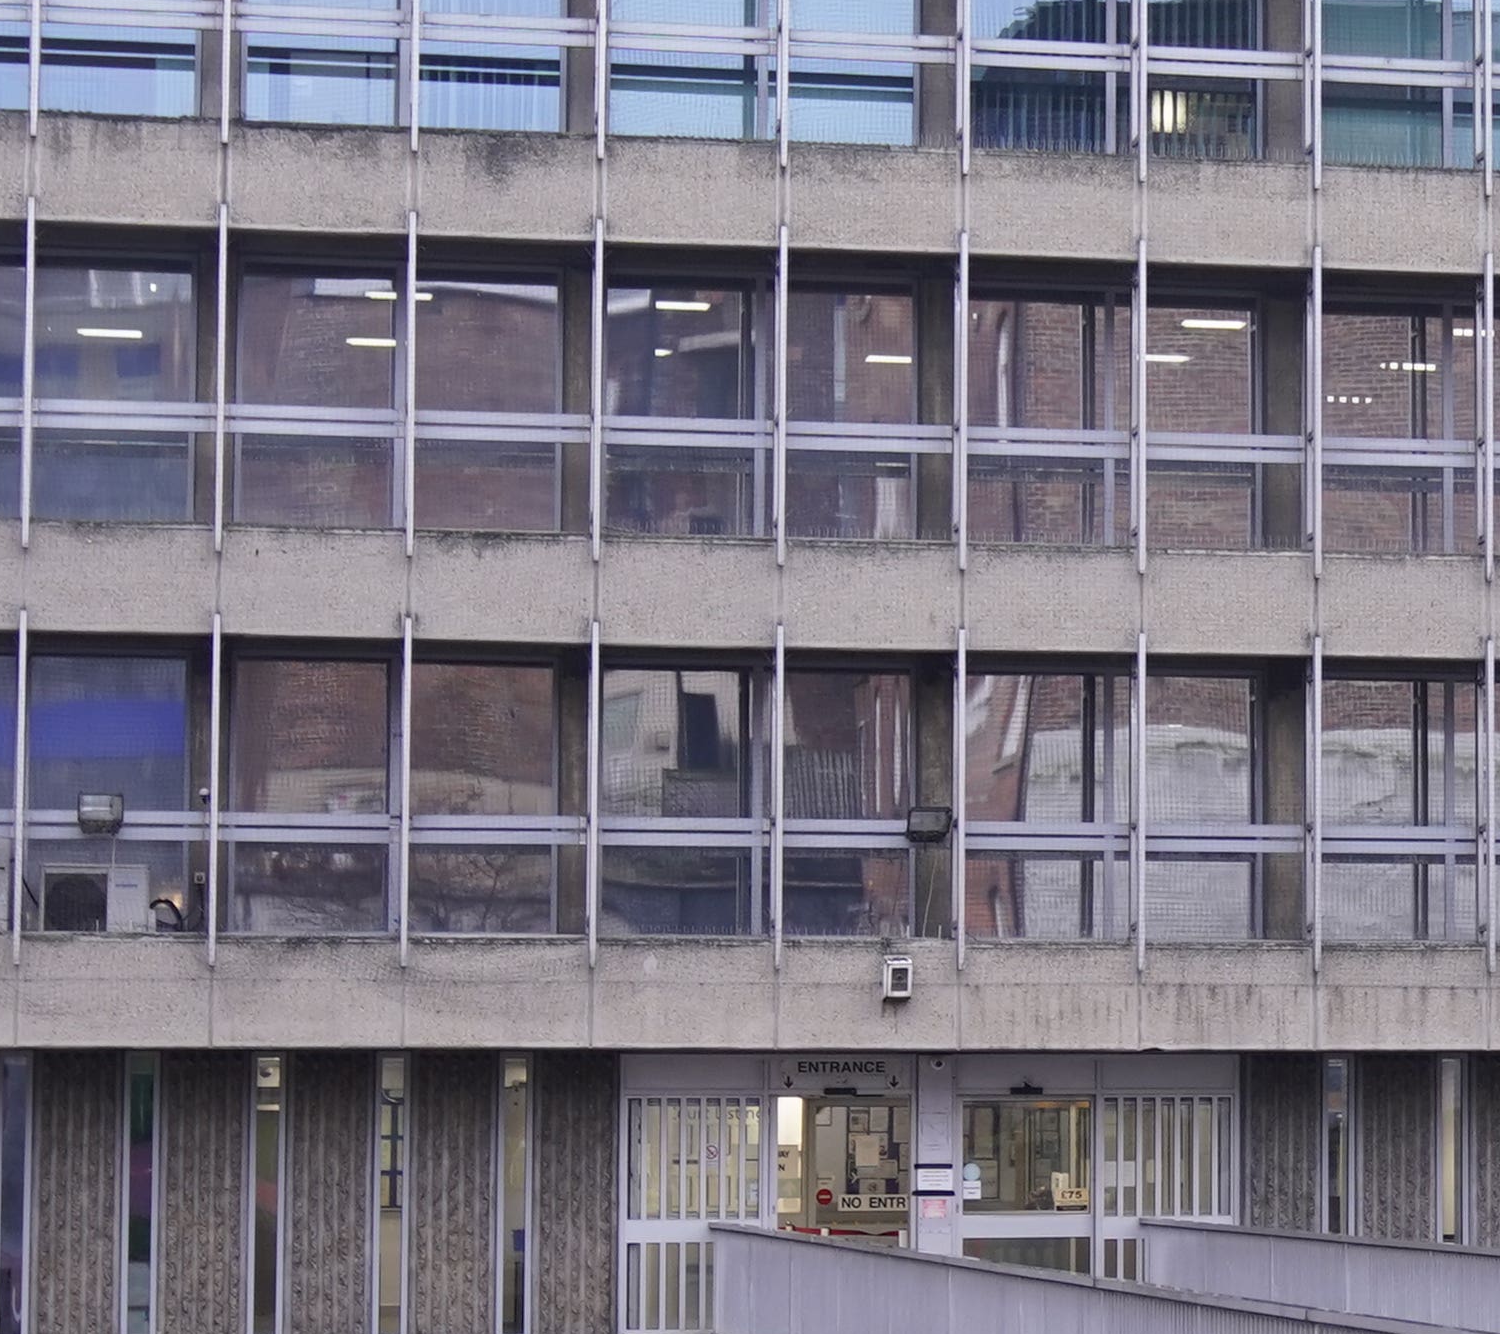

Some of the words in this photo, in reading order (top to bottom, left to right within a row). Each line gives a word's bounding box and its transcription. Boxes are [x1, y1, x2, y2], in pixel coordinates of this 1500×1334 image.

[797, 1061, 886, 1074] ENTRANCE
[841, 1196, 862, 1209] NO
[869, 1196, 908, 1209] ENTR
